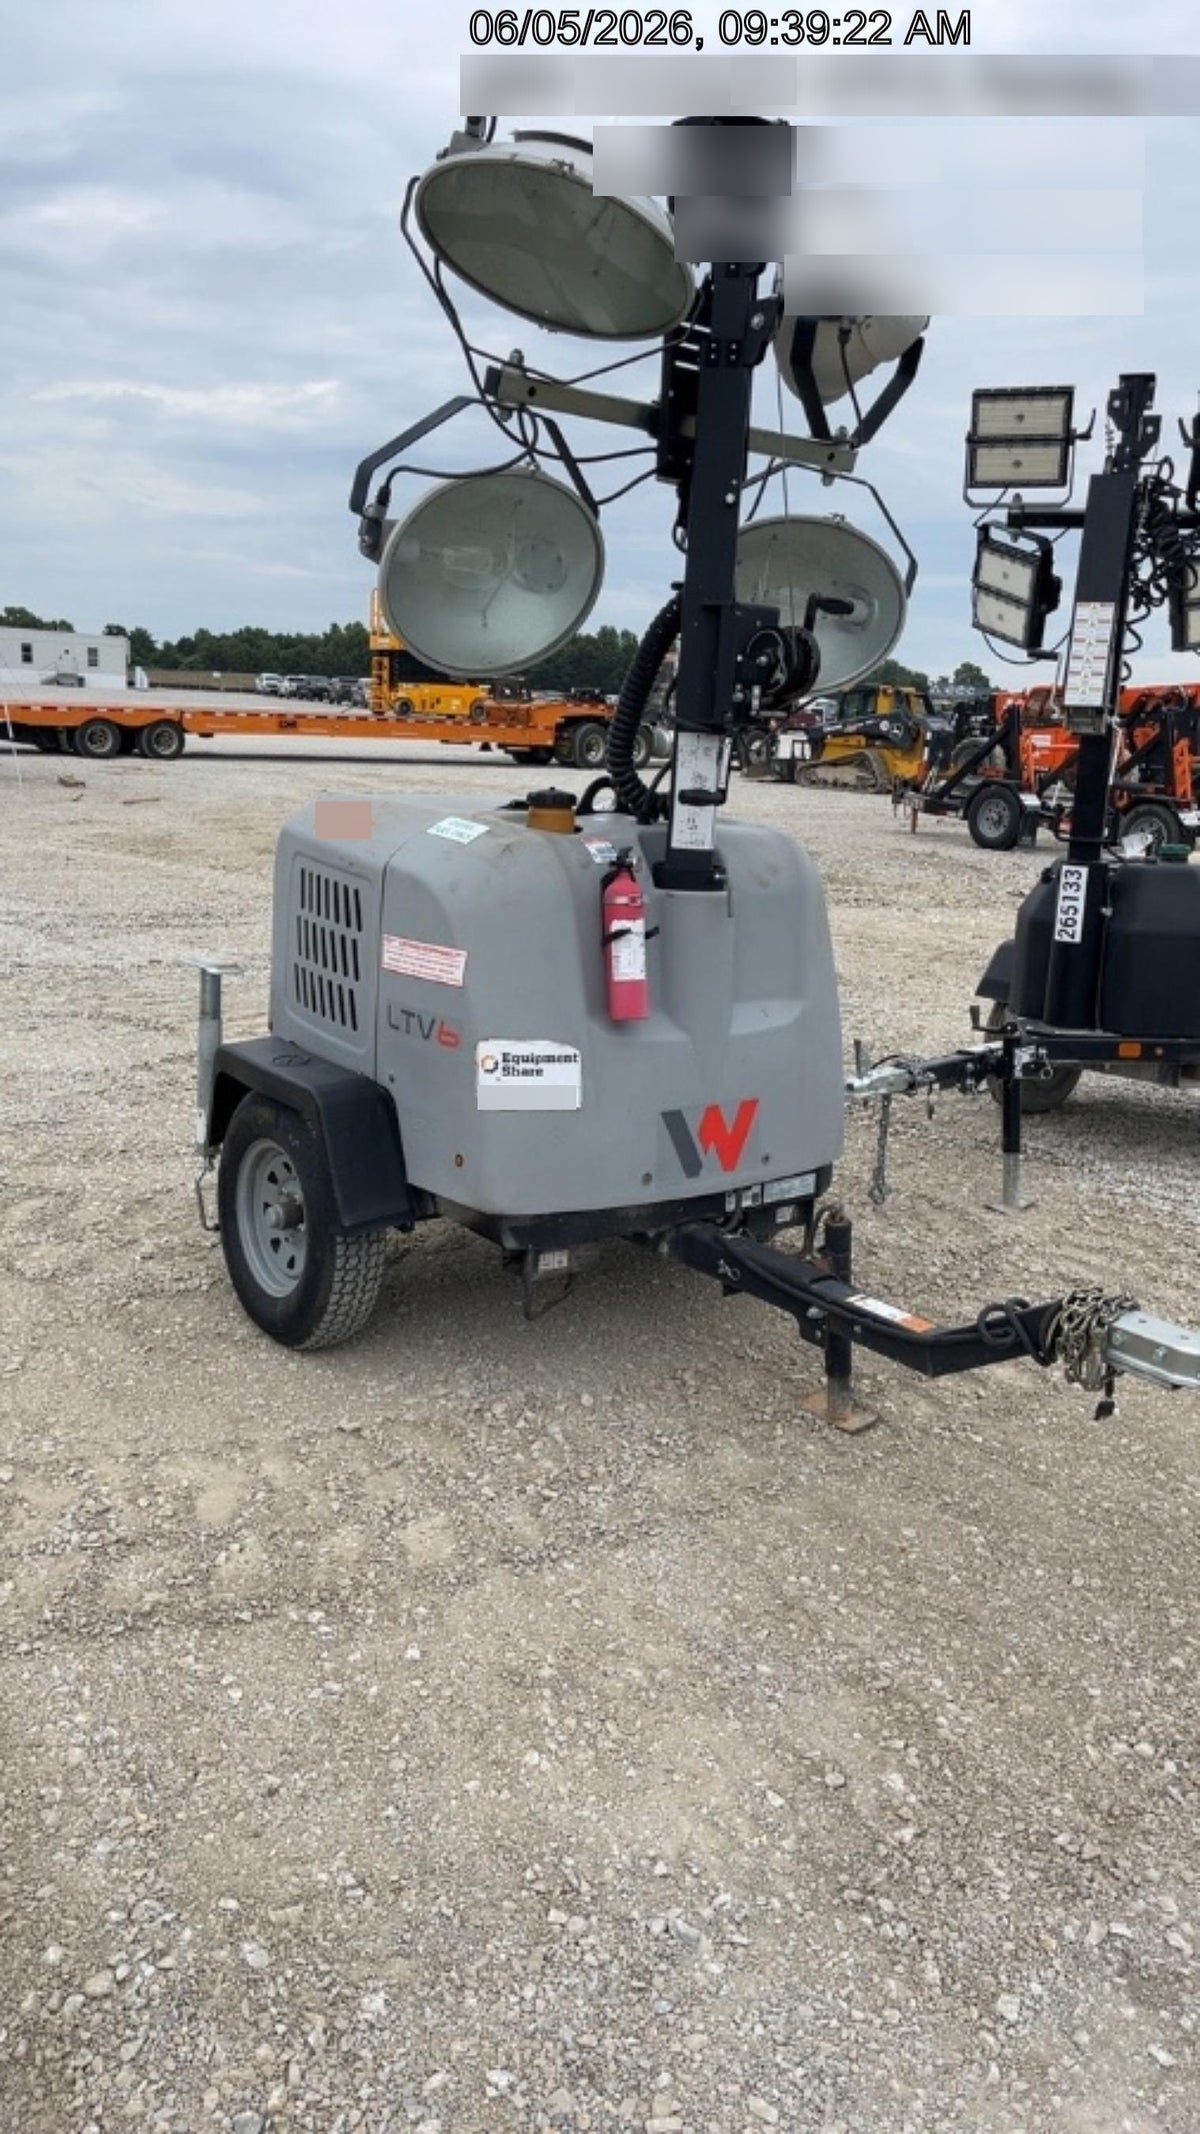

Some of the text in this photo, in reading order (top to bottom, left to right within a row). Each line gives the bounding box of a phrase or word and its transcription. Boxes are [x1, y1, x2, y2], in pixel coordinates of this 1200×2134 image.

[1058, 869, 1082, 940] 265133
[502, 1052, 579, 1065] Equipment
[502, 1066, 544, 1077] Share
